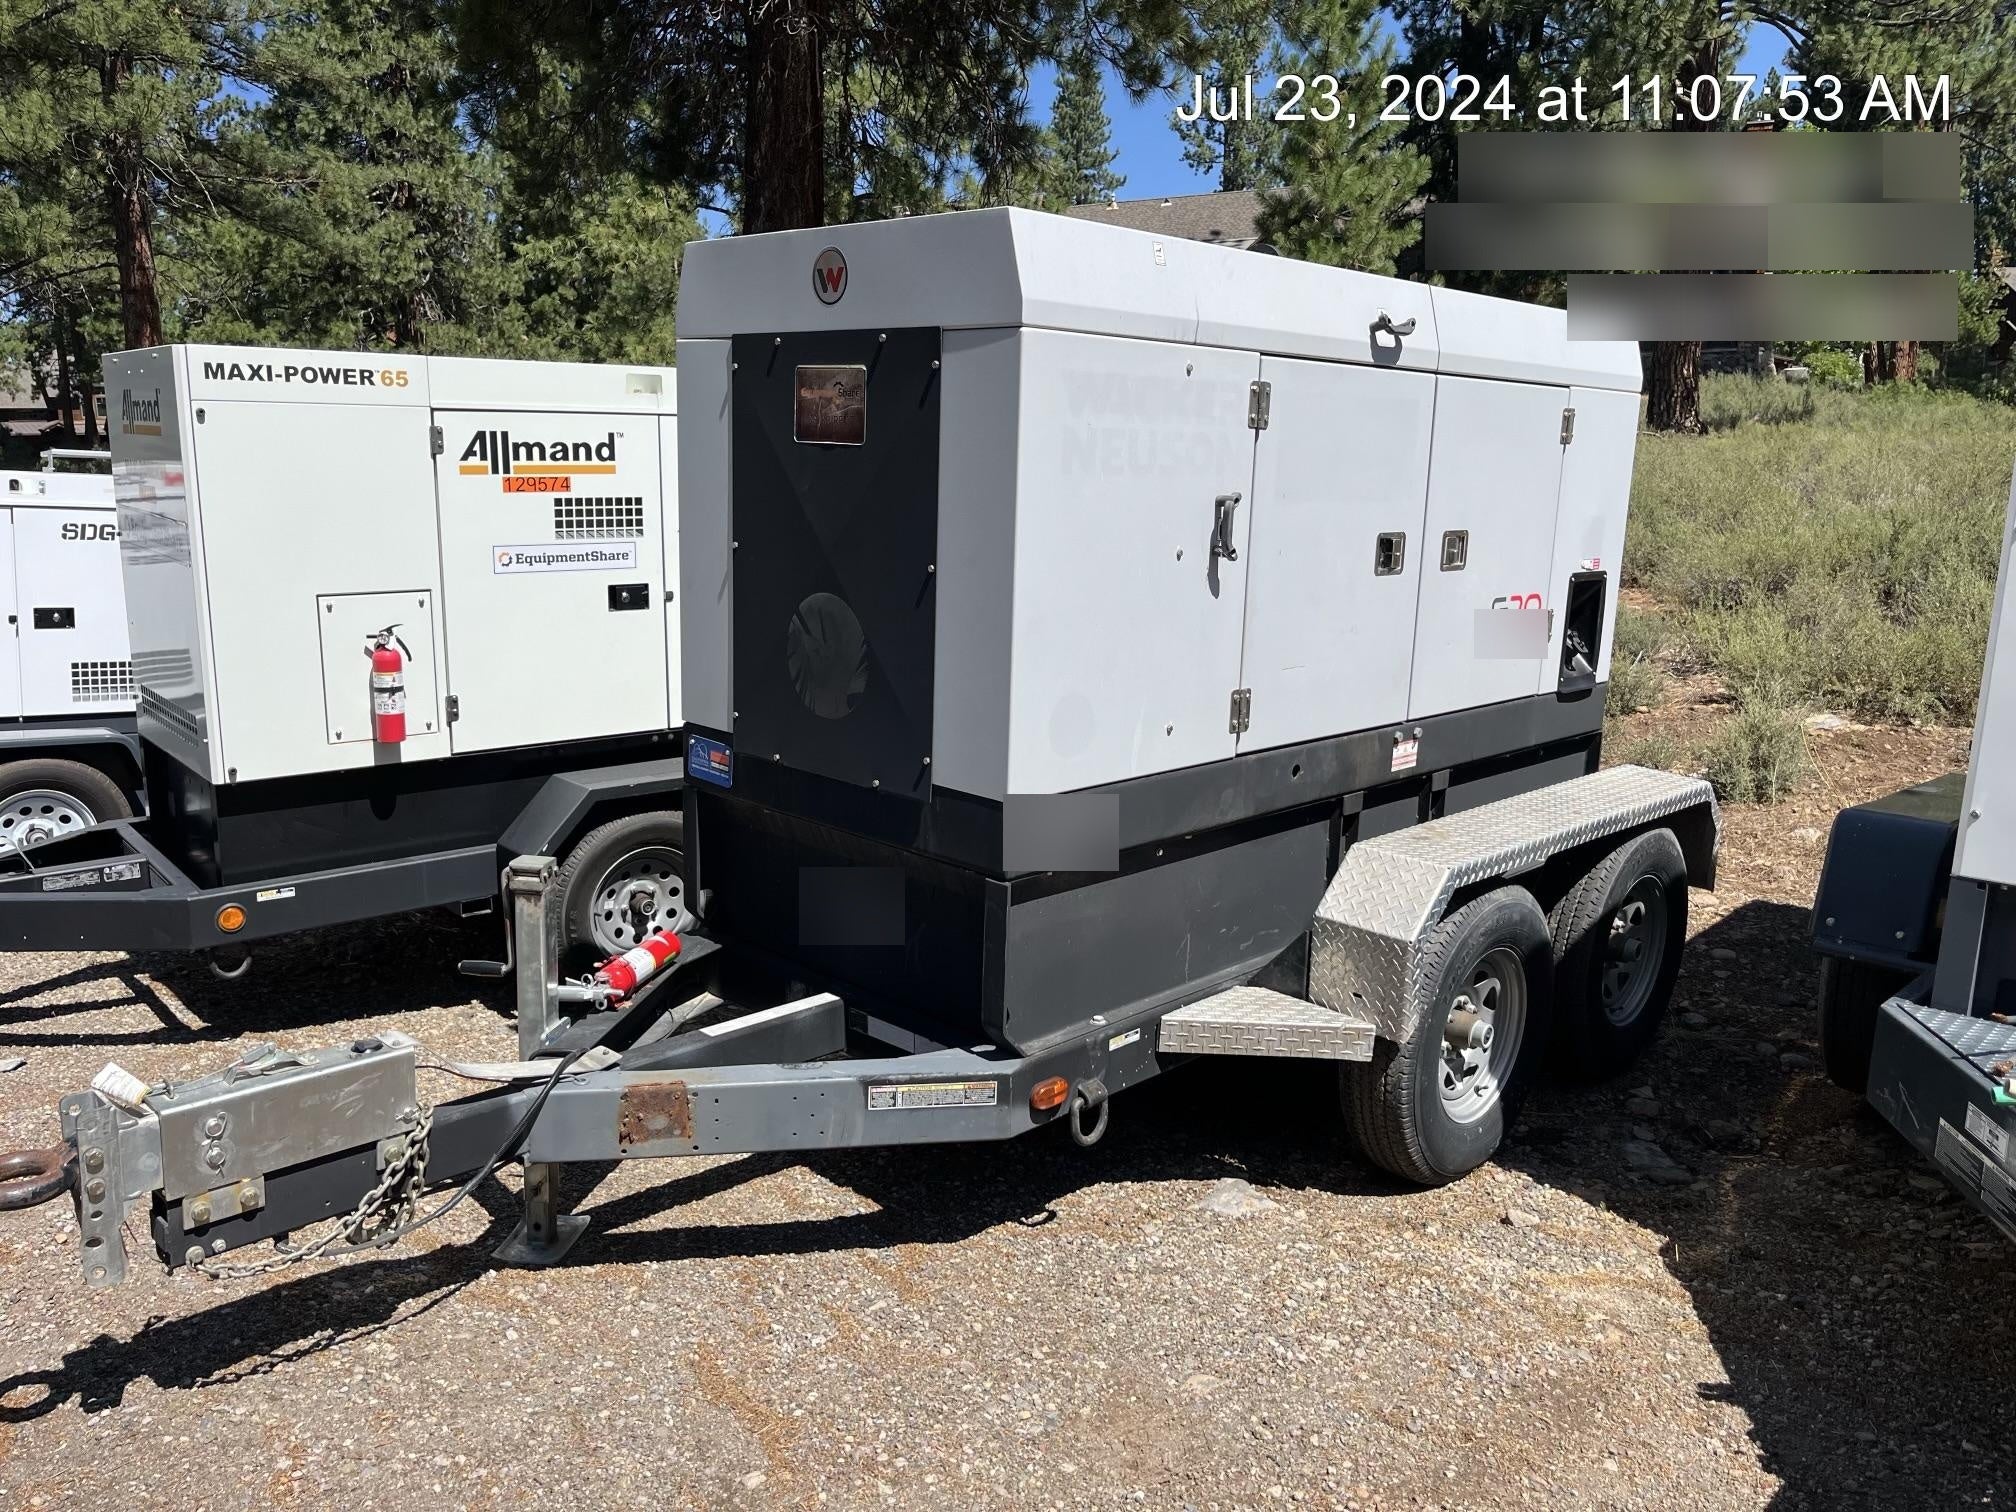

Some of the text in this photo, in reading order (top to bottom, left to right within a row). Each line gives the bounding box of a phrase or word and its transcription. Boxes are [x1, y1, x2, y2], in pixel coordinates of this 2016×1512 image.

[121, 388, 161, 434] Allmand
[459, 430, 616, 475] Allmand
[504, 476, 571, 492] 129574
[515, 550, 629, 567] EquipmentShare
